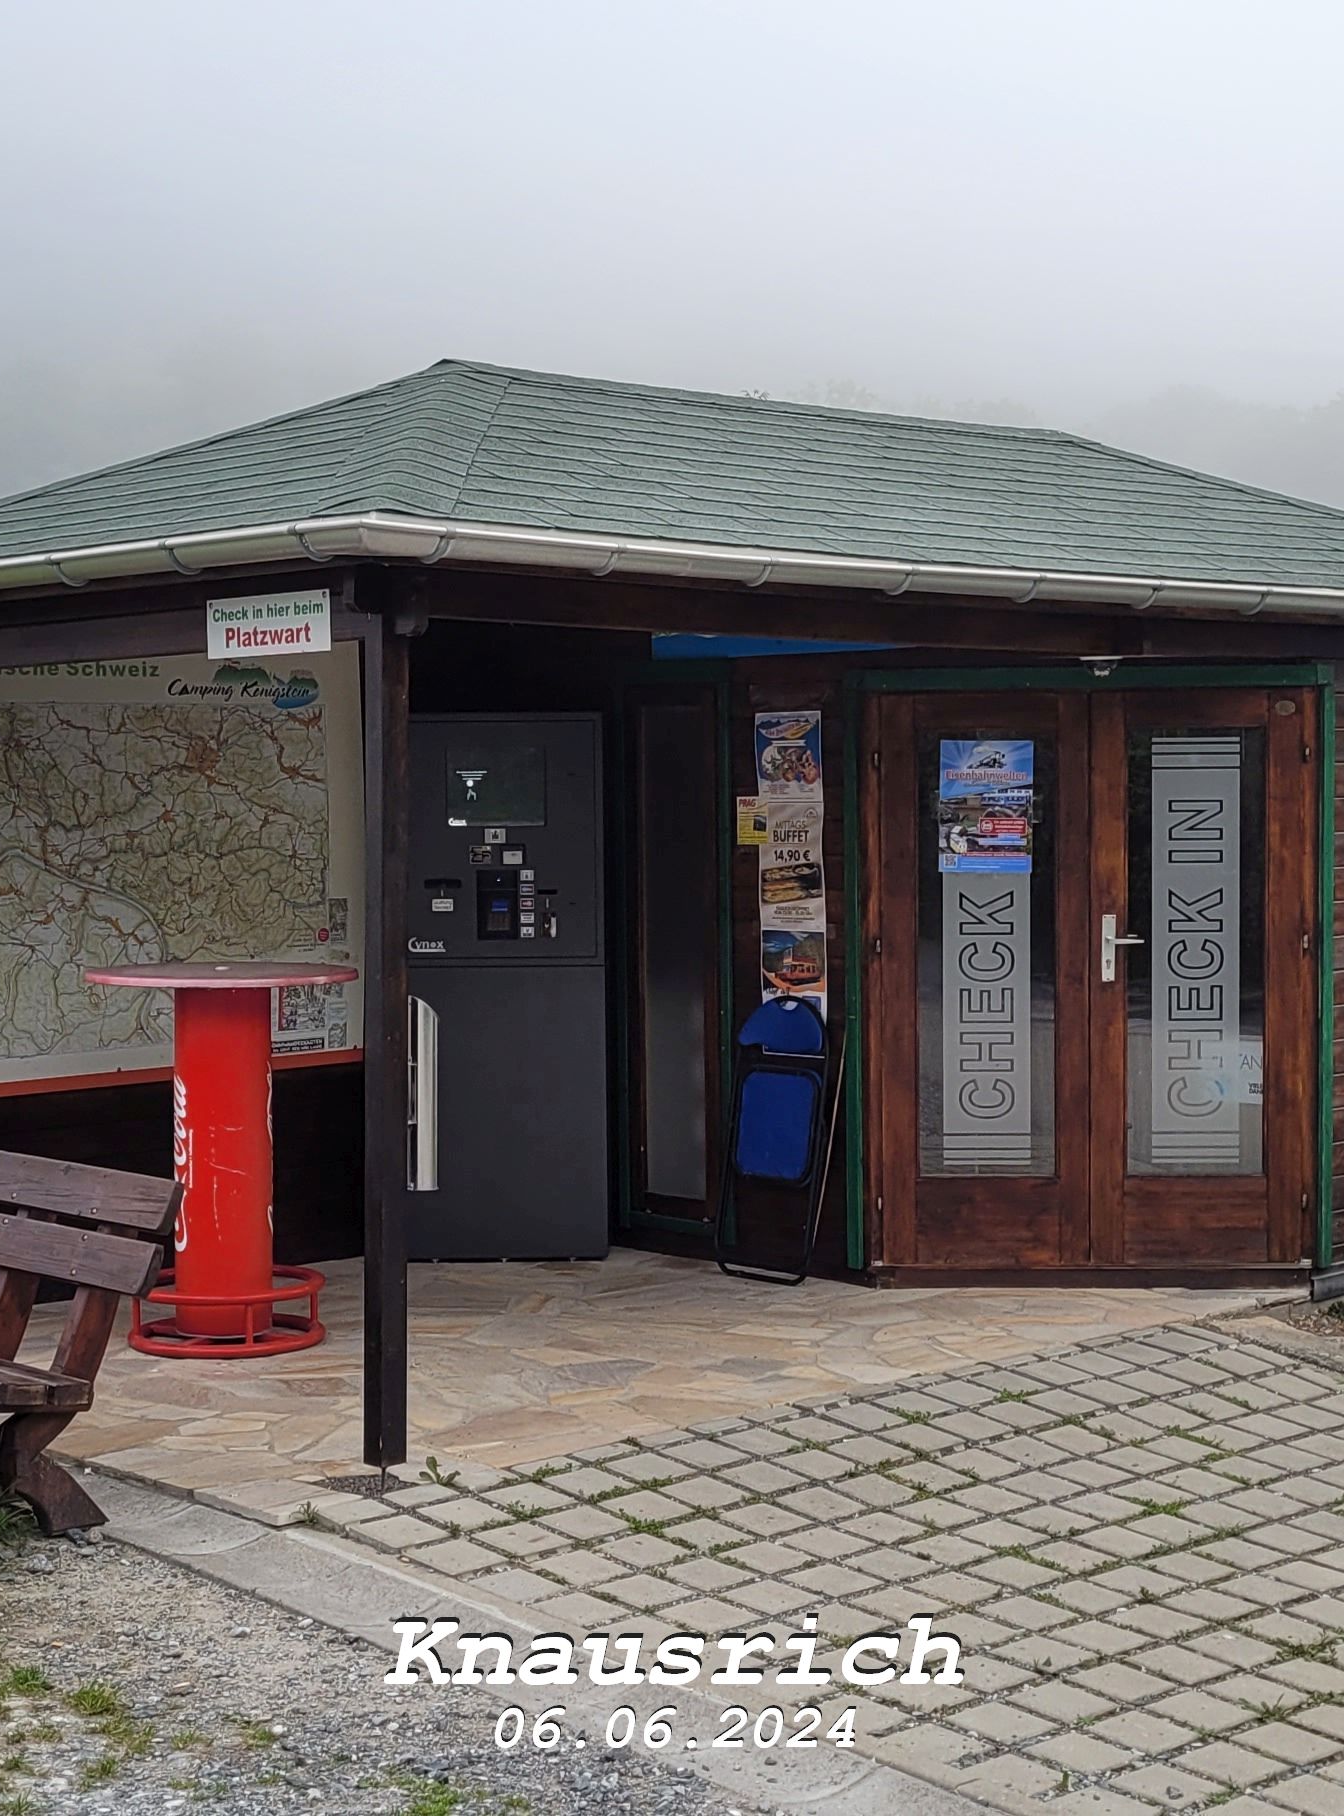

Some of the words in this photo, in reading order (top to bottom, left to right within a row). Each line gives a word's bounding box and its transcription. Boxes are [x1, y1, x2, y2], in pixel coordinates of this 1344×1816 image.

[213, 608, 249, 622] Check
[252, 605, 263, 620] in
[267, 603, 290, 618] hier
[294, 600, 324, 616] beim
[225, 621, 311, 649] Platzwart
[66, 661, 160, 678] Schweiz
[168, 678, 233, 702] Camping
[739, 799, 757, 808] PRAG
[773, 830, 809, 843] BUFFET
[1167, 798, 1224, 864] IN
[774, 850, 801, 863] 14,90
[803, 850, 811, 861] €
[958, 889, 1016, 1120] CHECK
[1167, 887, 1224, 1117] CHECK
